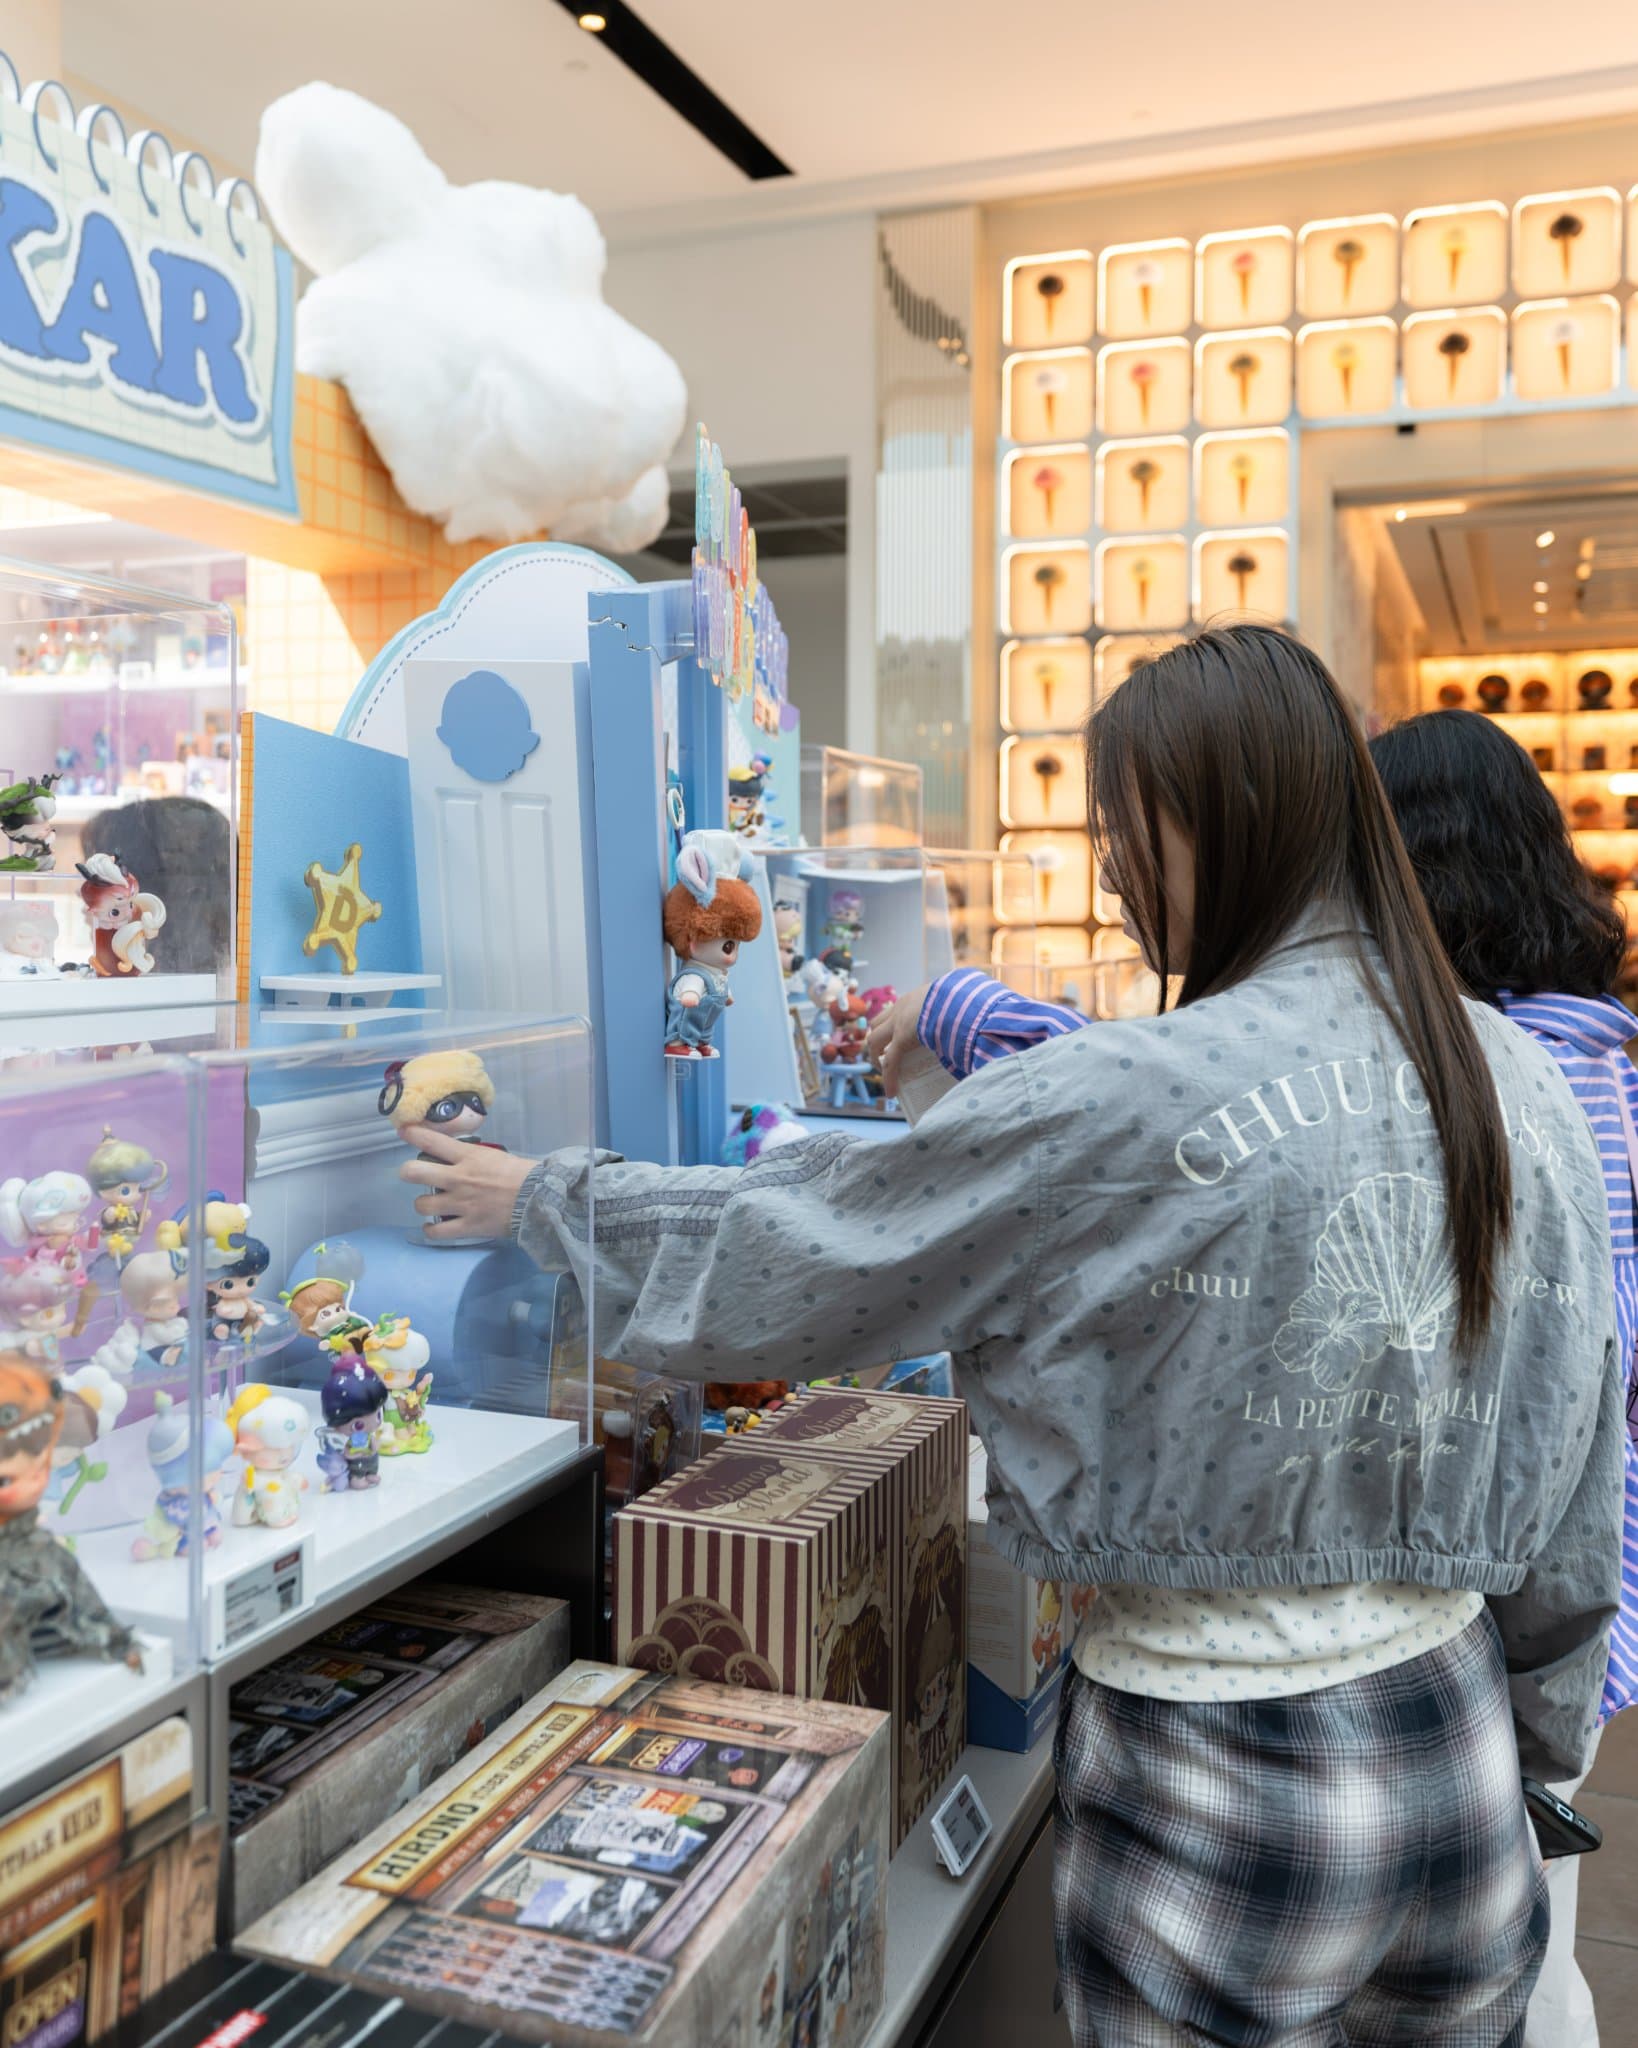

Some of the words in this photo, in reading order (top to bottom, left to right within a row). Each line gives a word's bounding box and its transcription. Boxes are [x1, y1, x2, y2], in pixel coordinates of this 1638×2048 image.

[328, 886, 359, 934] D
[1174, 1057, 1373, 1186] CHUU
[1150, 1266, 1252, 1300] chuu
[797, 1402, 865, 1439] Dimoo
[834, 1405, 897, 1441] World
[1243, 1391, 1284, 1428] LA
[696, 1463, 777, 1507] Dimoo
[736, 1467, 813, 1512] World
[638, 1737, 681, 1767] OPEN
[371, 1802, 480, 1878] HIRONO
